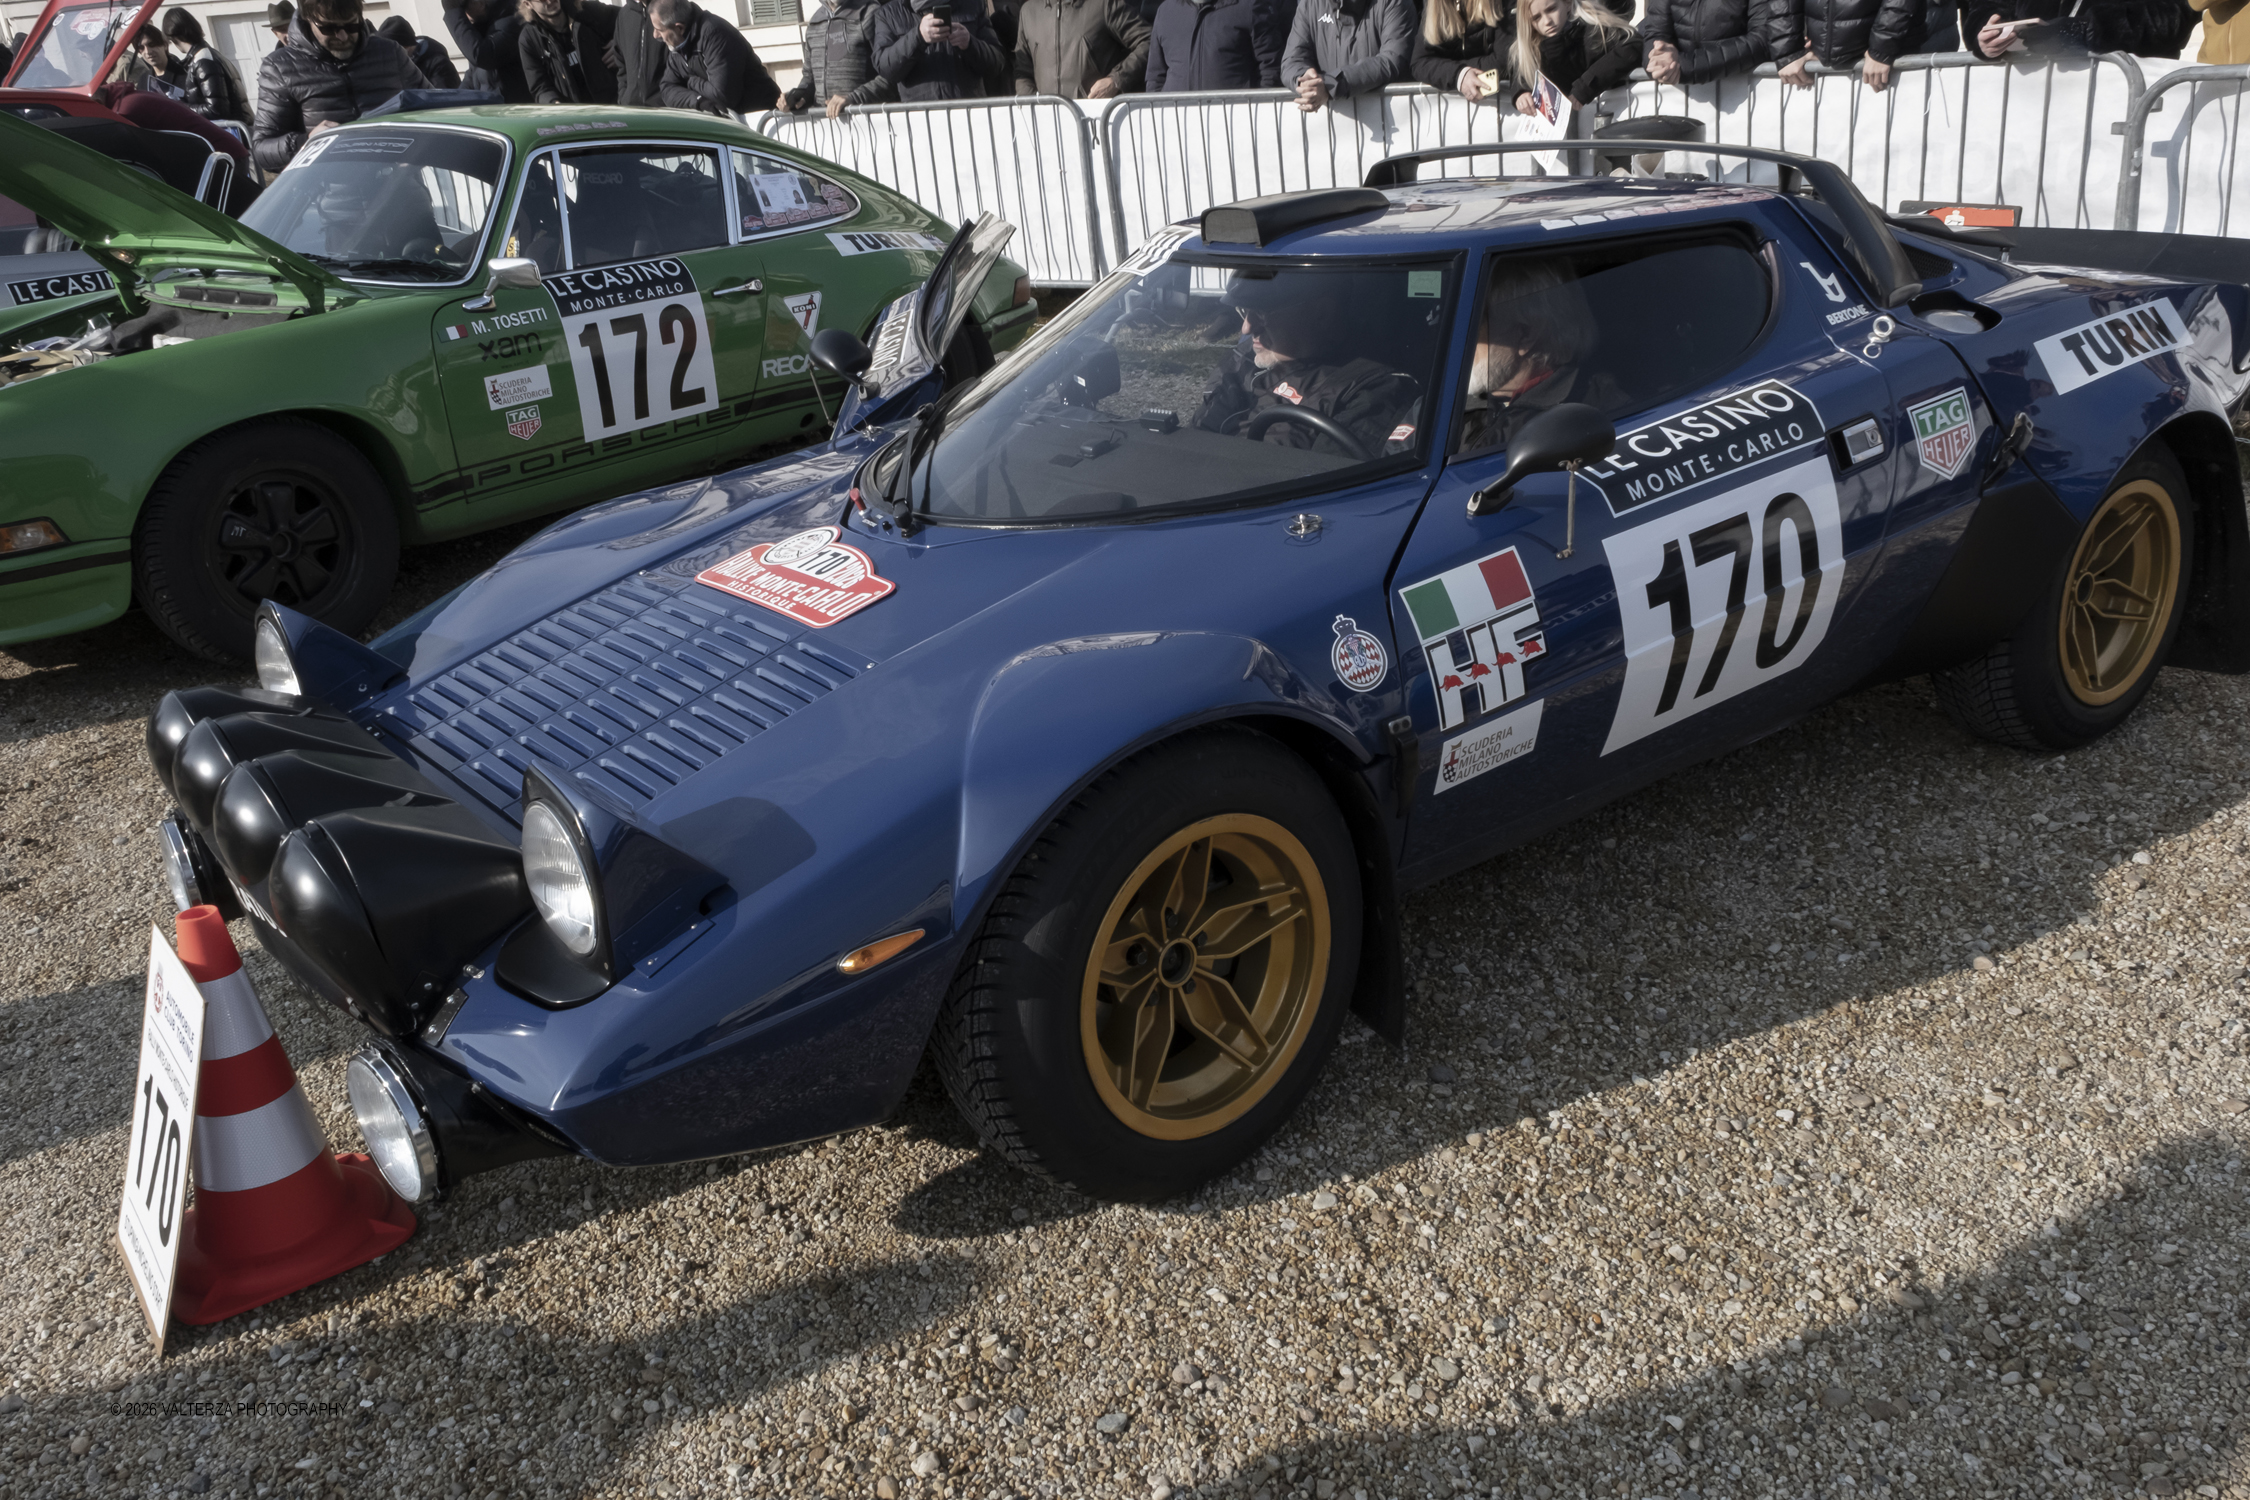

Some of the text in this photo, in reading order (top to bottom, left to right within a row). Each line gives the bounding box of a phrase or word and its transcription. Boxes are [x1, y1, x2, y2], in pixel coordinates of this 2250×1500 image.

[582, 171, 623, 185] RECARO
[842, 233, 923, 251] TURIN
[14, 282, 44, 302] LE
[547, 260, 681, 297] LE CASINO
[471, 307, 548, 335] M. TOSETTI
[793, 304, 816, 313] KONI
[1826, 304, 1869, 326] BERTONE
[478, 332, 542, 362] xam
[870, 325, 905, 371] CASINO
[2060, 306, 2178, 376] TURIN
[578, 303, 706, 428] 172
[499, 377, 532, 389] SCUDERIA
[500, 385, 527, 397] MILANO
[502, 387, 551, 405] AUTOSTORICHE
[509, 408, 537, 423] TAG
[510, 420, 540, 438] HEUER
[1918, 400, 1964, 433] TAG
[479, 406, 731, 486] PORSCHE
[1584, 389, 1794, 480] LE CASINO
[1924, 427, 1969, 468] HEUER
[711, 551, 766, 583] RALLYE
[797, 550, 851, 575] 170
[727, 580, 797, 611] HISTORIQUE
[1645, 492, 1823, 717] 170
[1422, 600, 1549, 732] HF
[1459, 742, 1502, 770] MILANO
[1461, 726, 1513, 758] SCUDERIA
[1455, 737, 1534, 782] AUTOSTORICHE
[166, 990, 195, 1046] AUTOMOBILE
[164, 1005, 194, 1064] CLUB TORINO
[135, 1073, 181, 1247] 170
